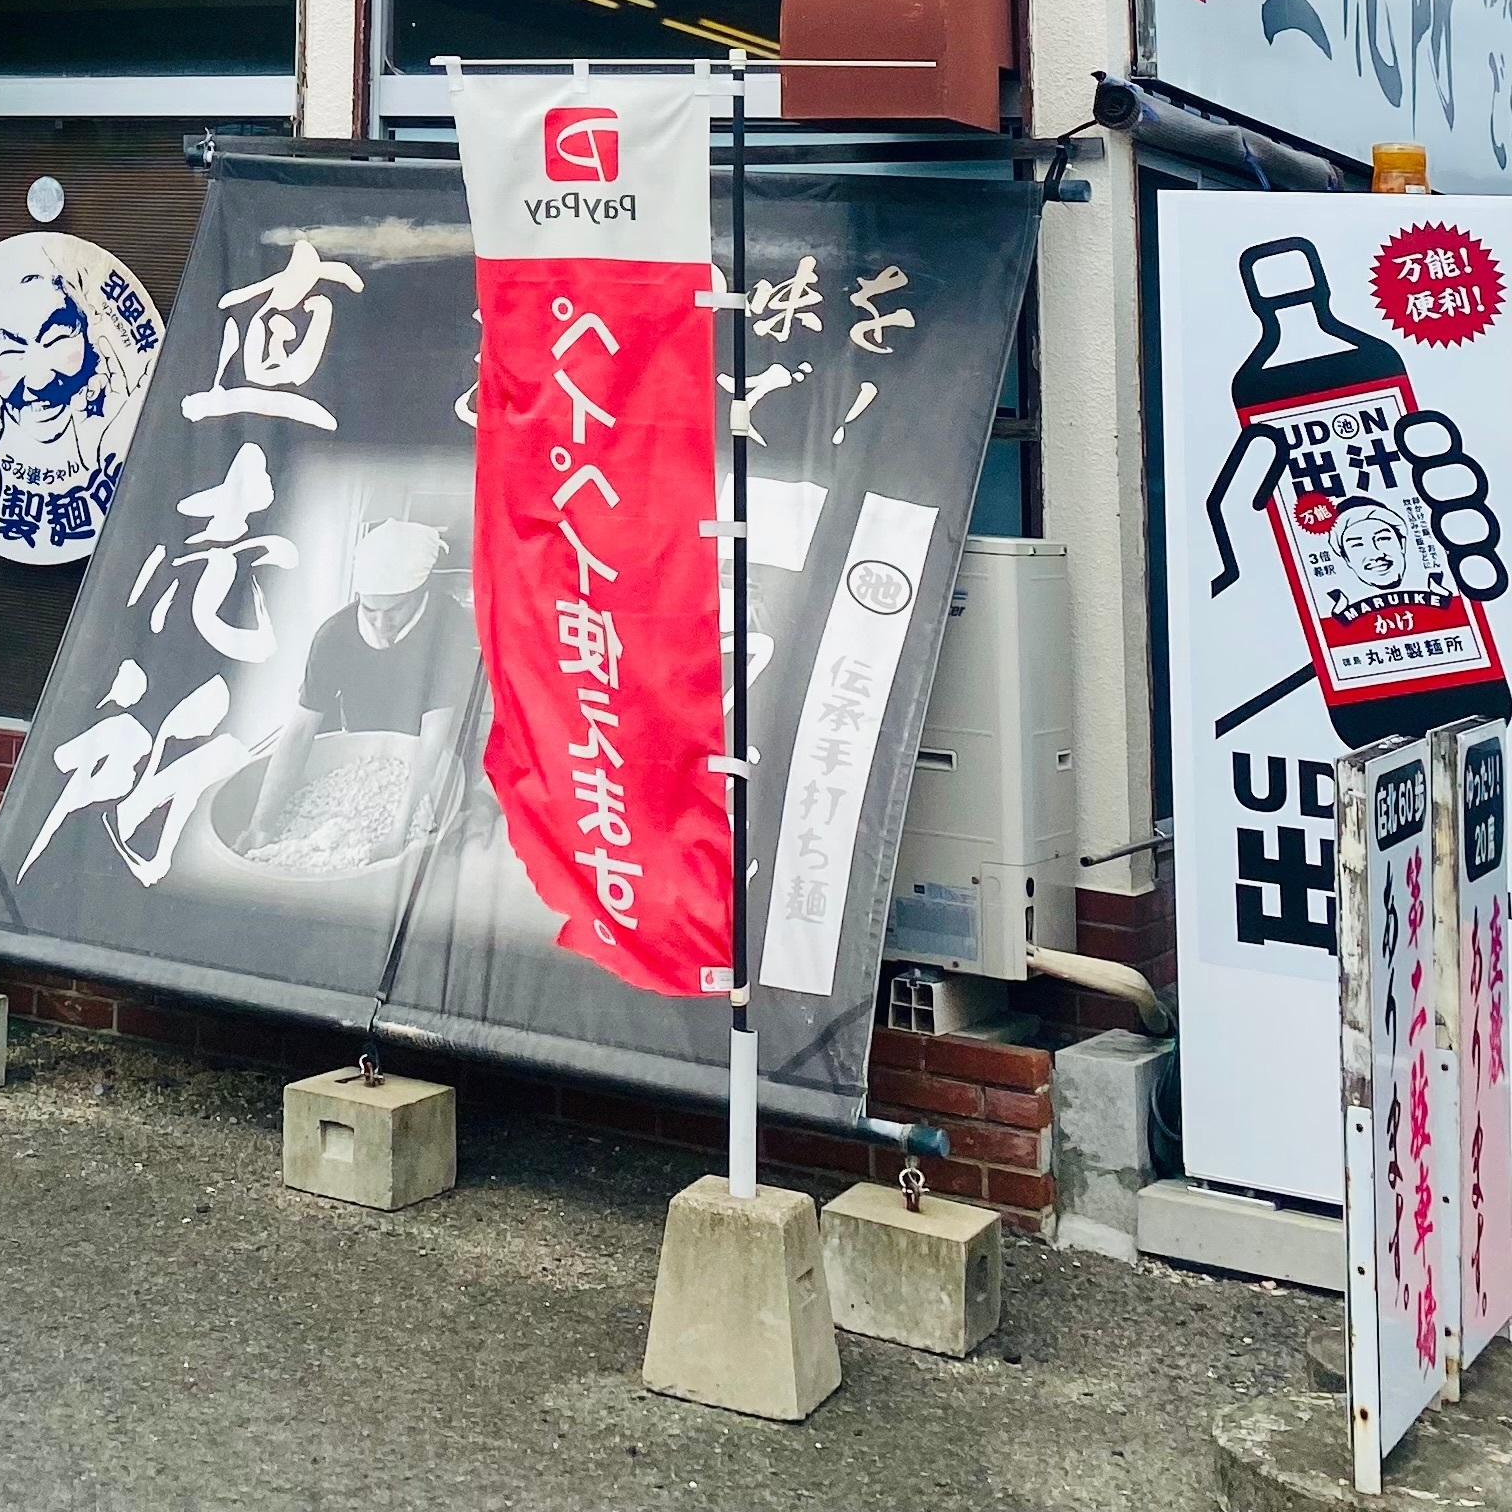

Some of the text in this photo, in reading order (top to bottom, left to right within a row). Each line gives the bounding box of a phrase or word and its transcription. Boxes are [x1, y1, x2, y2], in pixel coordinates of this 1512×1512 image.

[1393, 246, 1472, 283] 万能!
[1405, 285, 1486, 322] 便利!
[1288, 438, 1402, 499] 出汁
[1299, 504, 1333, 525] 万能
[16, 239, 365, 888] 直売所
[1343, 592, 1441, 621] MARUIKE
[1374, 610, 1414, 635] かけ
[1365, 635, 1464, 666] 丸池製麺所
[784, 654, 874, 926] 伝承手打ち麺
[1236, 825, 1339, 957] 出
[1381, 858, 1411, 1312] あります。
[1406, 844, 1438, 1383] 第二駐車場
